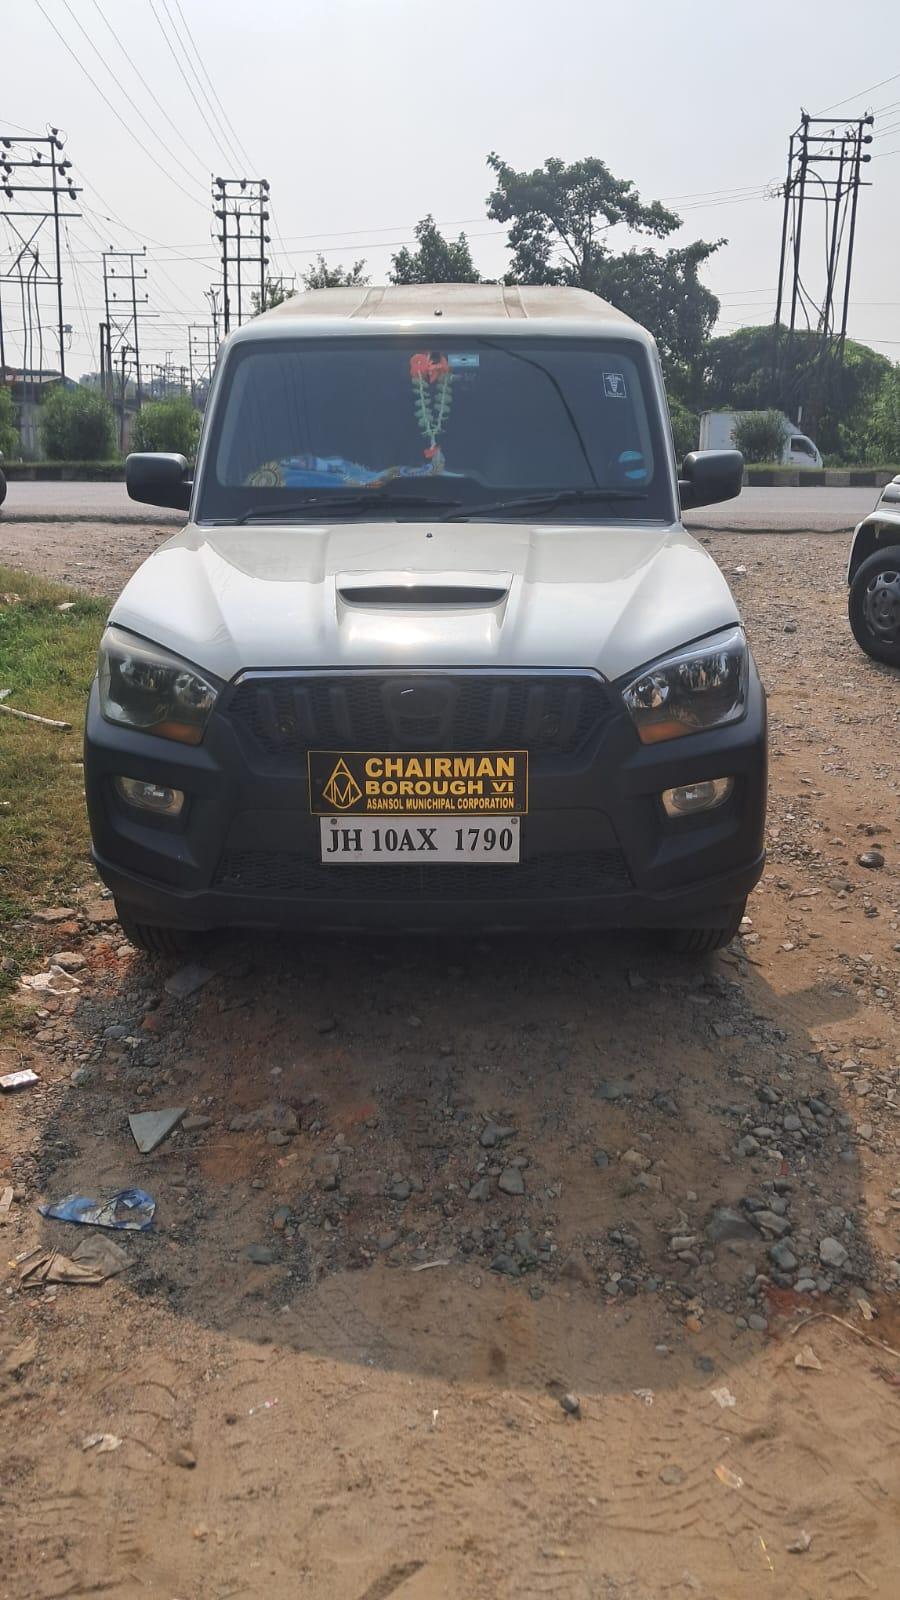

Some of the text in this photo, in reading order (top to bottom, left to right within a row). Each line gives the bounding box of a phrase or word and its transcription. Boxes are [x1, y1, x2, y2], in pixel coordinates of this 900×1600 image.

[365, 757, 515, 777] CHAIRMAN
[365, 780, 515, 795] BOROUGH VI
[367, 797, 514, 810] ASANSOL MUNICHIPAL CORPORATION
[327, 828, 513, 852] JH 10AX 1790
